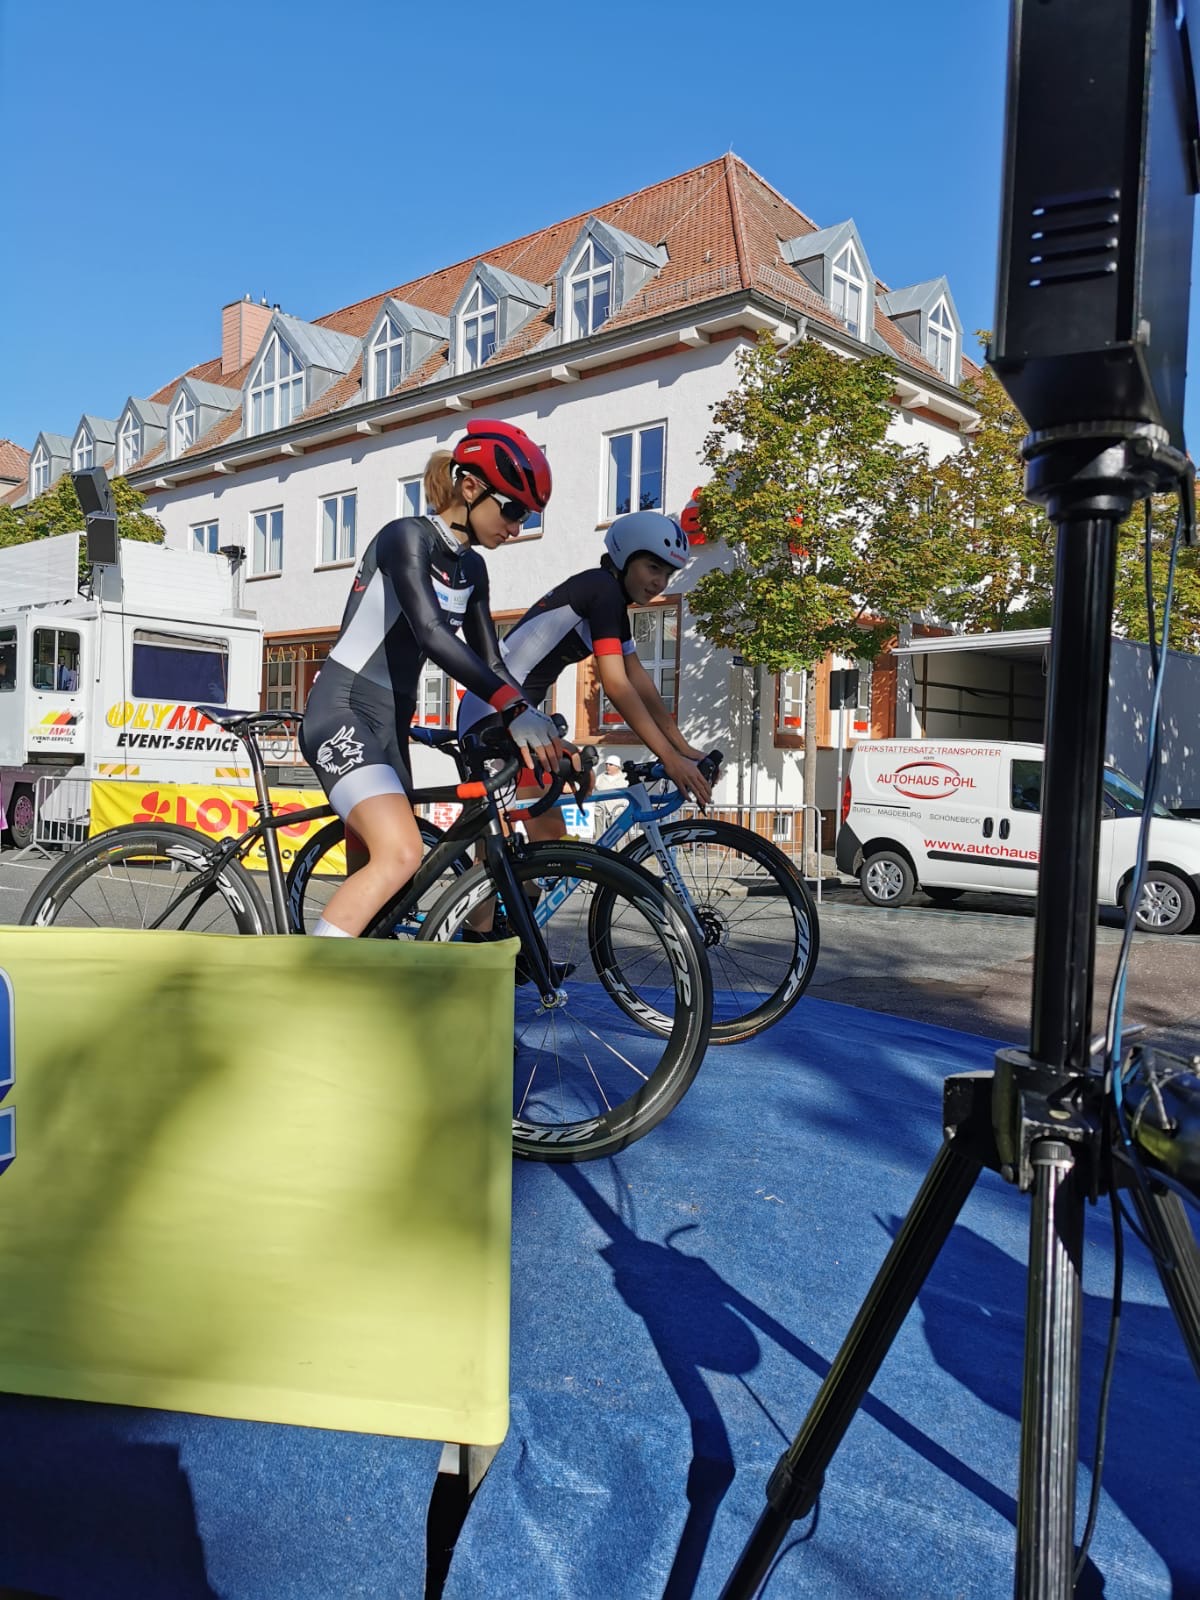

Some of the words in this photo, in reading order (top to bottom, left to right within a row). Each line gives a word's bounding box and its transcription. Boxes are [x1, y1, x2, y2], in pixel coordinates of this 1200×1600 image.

[106, 701, 225, 732] OLYMP
[116, 733, 240, 752] EVENT-SERVICE
[857, 745, 1002, 757] WERKSTATTERSATZ-TRANSPORTER
[877, 773, 939, 786] AUTOHAUS
[176, 796, 311, 838] LOTO
[562, 806, 590, 827] ER
[877, 808, 922, 819] MAGDEBURG
[924, 839, 1040, 860] www.autohaus
[656, 849, 686, 905] FOCUS
[633, 896, 692, 1008] ZIPP
[783, 905, 811, 1002] ZIPP
